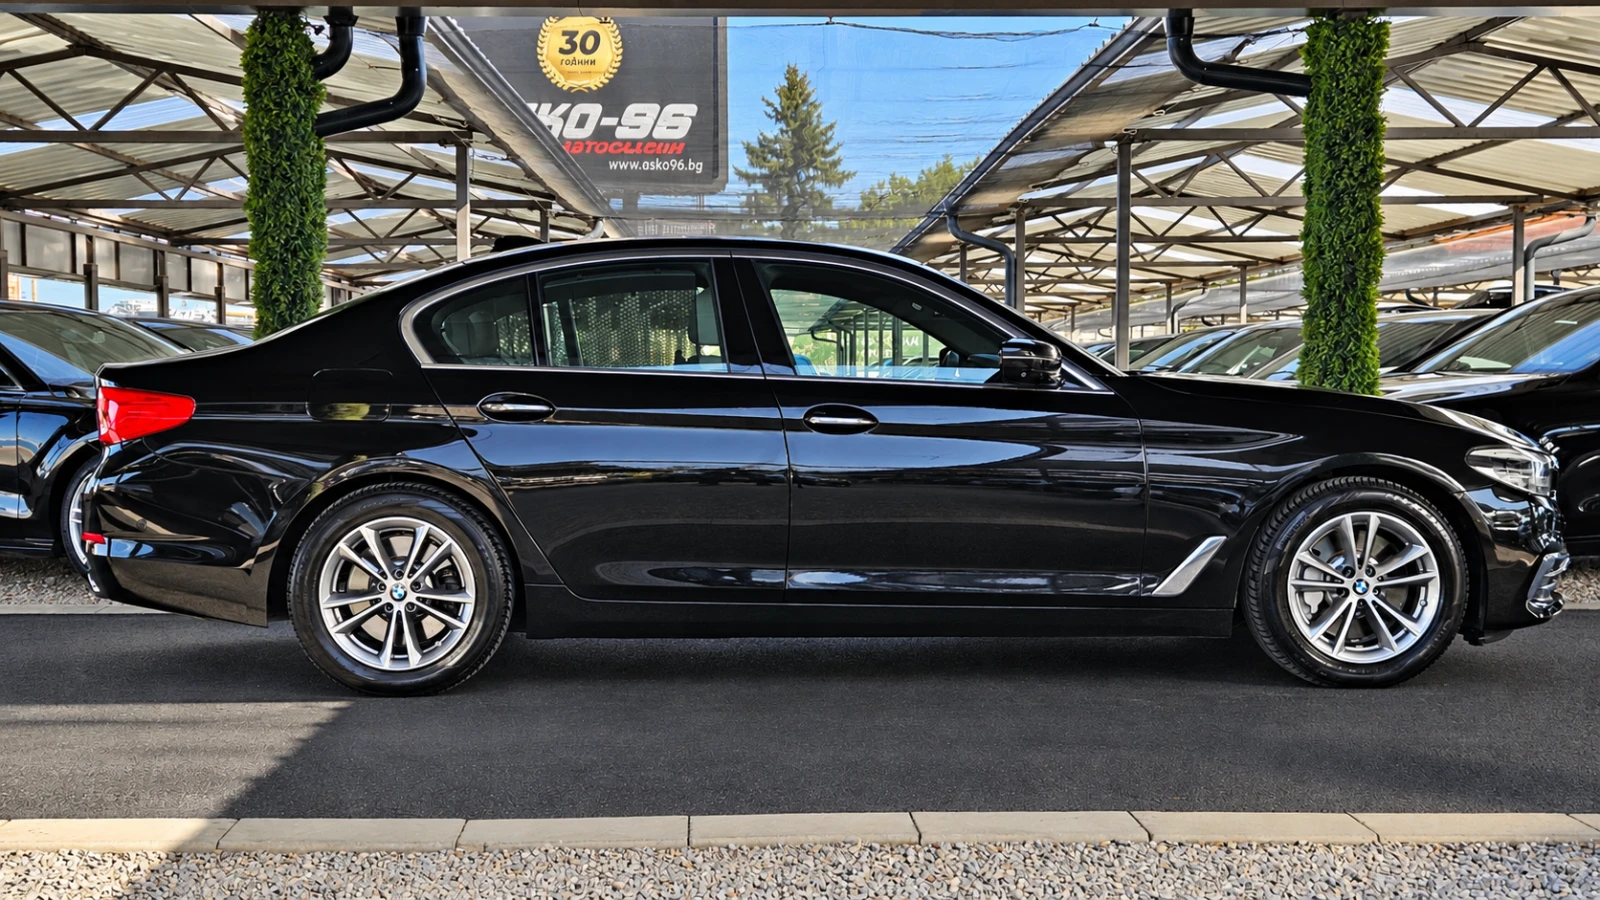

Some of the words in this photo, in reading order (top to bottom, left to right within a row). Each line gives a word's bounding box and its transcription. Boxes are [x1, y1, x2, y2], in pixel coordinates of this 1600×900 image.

[558, 30, 601, 55] 30
[526, 103, 698, 140] KO-96
[608, 158, 703, 174] www.asko96.bg
